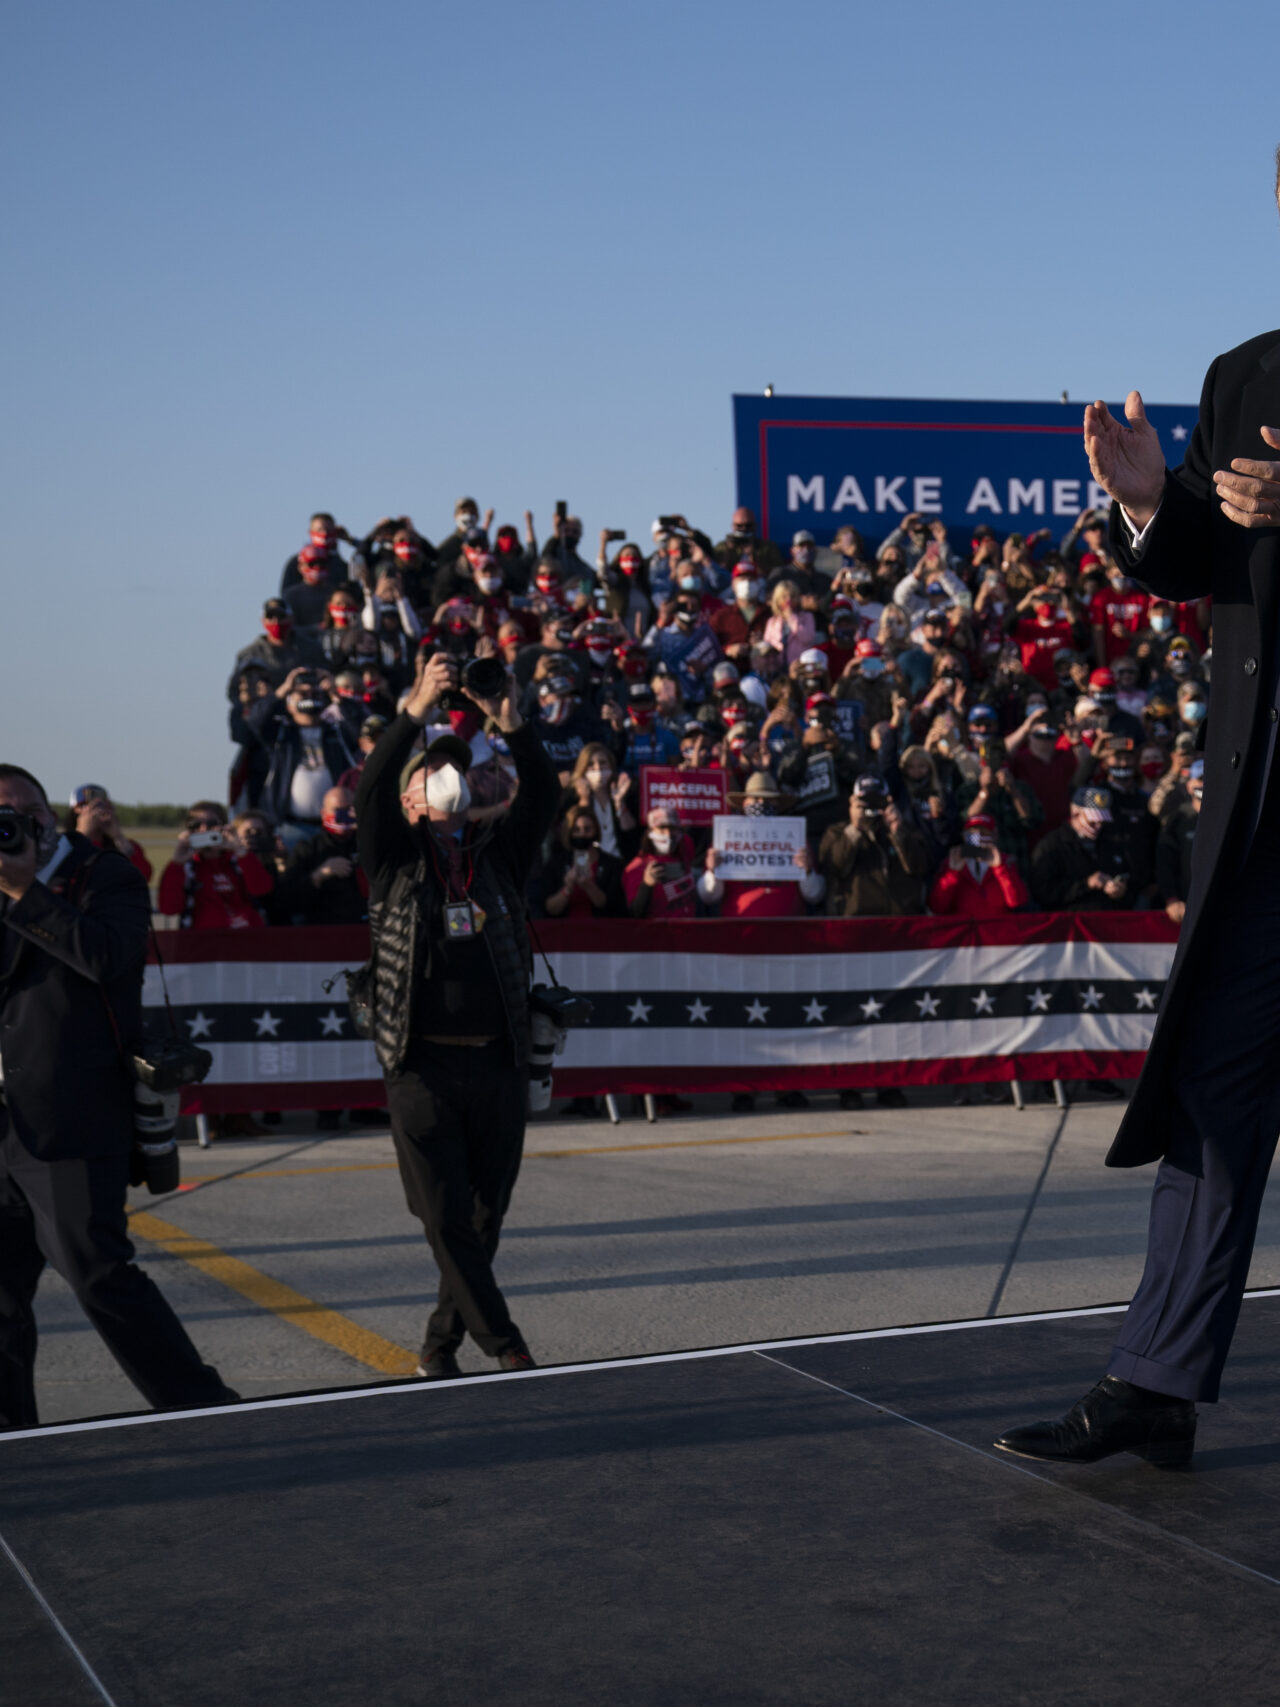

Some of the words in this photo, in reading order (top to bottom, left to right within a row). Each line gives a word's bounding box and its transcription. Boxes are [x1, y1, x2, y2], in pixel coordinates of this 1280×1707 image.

[786, 474, 943, 513] MAKE
[649, 782, 721, 797] PEACEFUL
[650, 797, 721, 810] PROTESTER
[725, 829, 758, 840] THIS
[766, 829, 779, 840] IS
[786, 829, 795, 840] A
[724, 841, 795, 852] PEACEFUL
[724, 853, 793, 867] PROTEST
